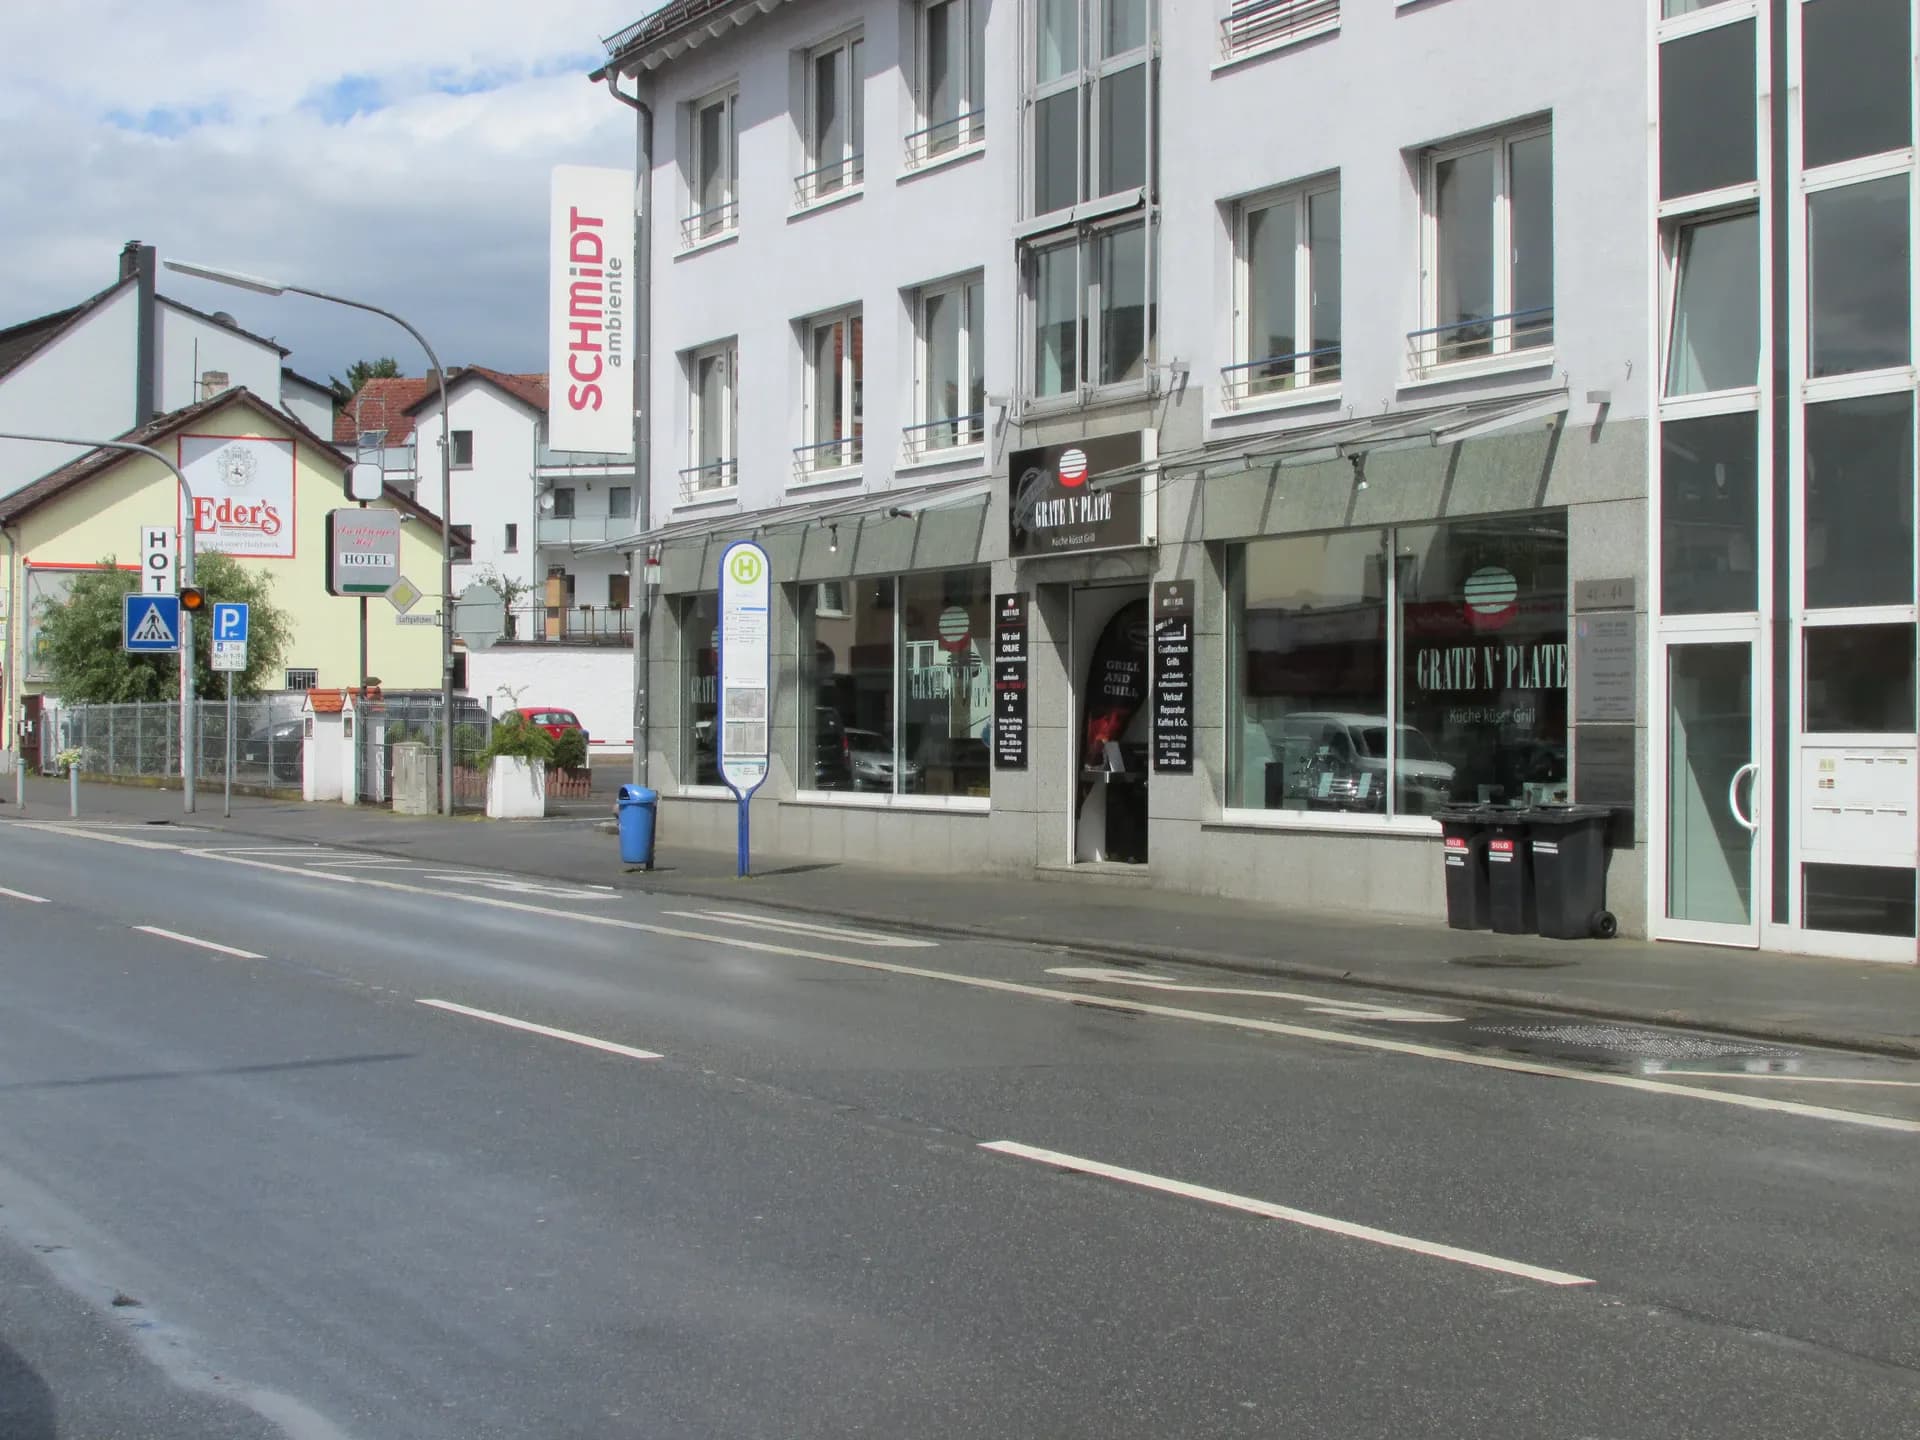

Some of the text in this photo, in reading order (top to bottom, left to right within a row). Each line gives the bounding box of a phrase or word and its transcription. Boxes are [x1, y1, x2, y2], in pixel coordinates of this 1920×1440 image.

[605, 257, 622, 368] ambiente
[192, 497, 282, 536] Eder's
[1035, 498, 1066, 528] GRATE
[1081, 492, 1112, 523] PLATE
[344, 554, 392, 566] HOTEL
[221, 608, 240, 638] P
[1104, 672, 1131, 684] AND
[1417, 647, 1477, 690] GRATE
[1506, 643, 1568, 689] PLATE
[1162, 691, 1183, 701] Verkauf
[1450, 708, 1482, 724] Küche
[1513, 707, 1536, 724] Grill
[1491, 841, 1509, 849] SULO
